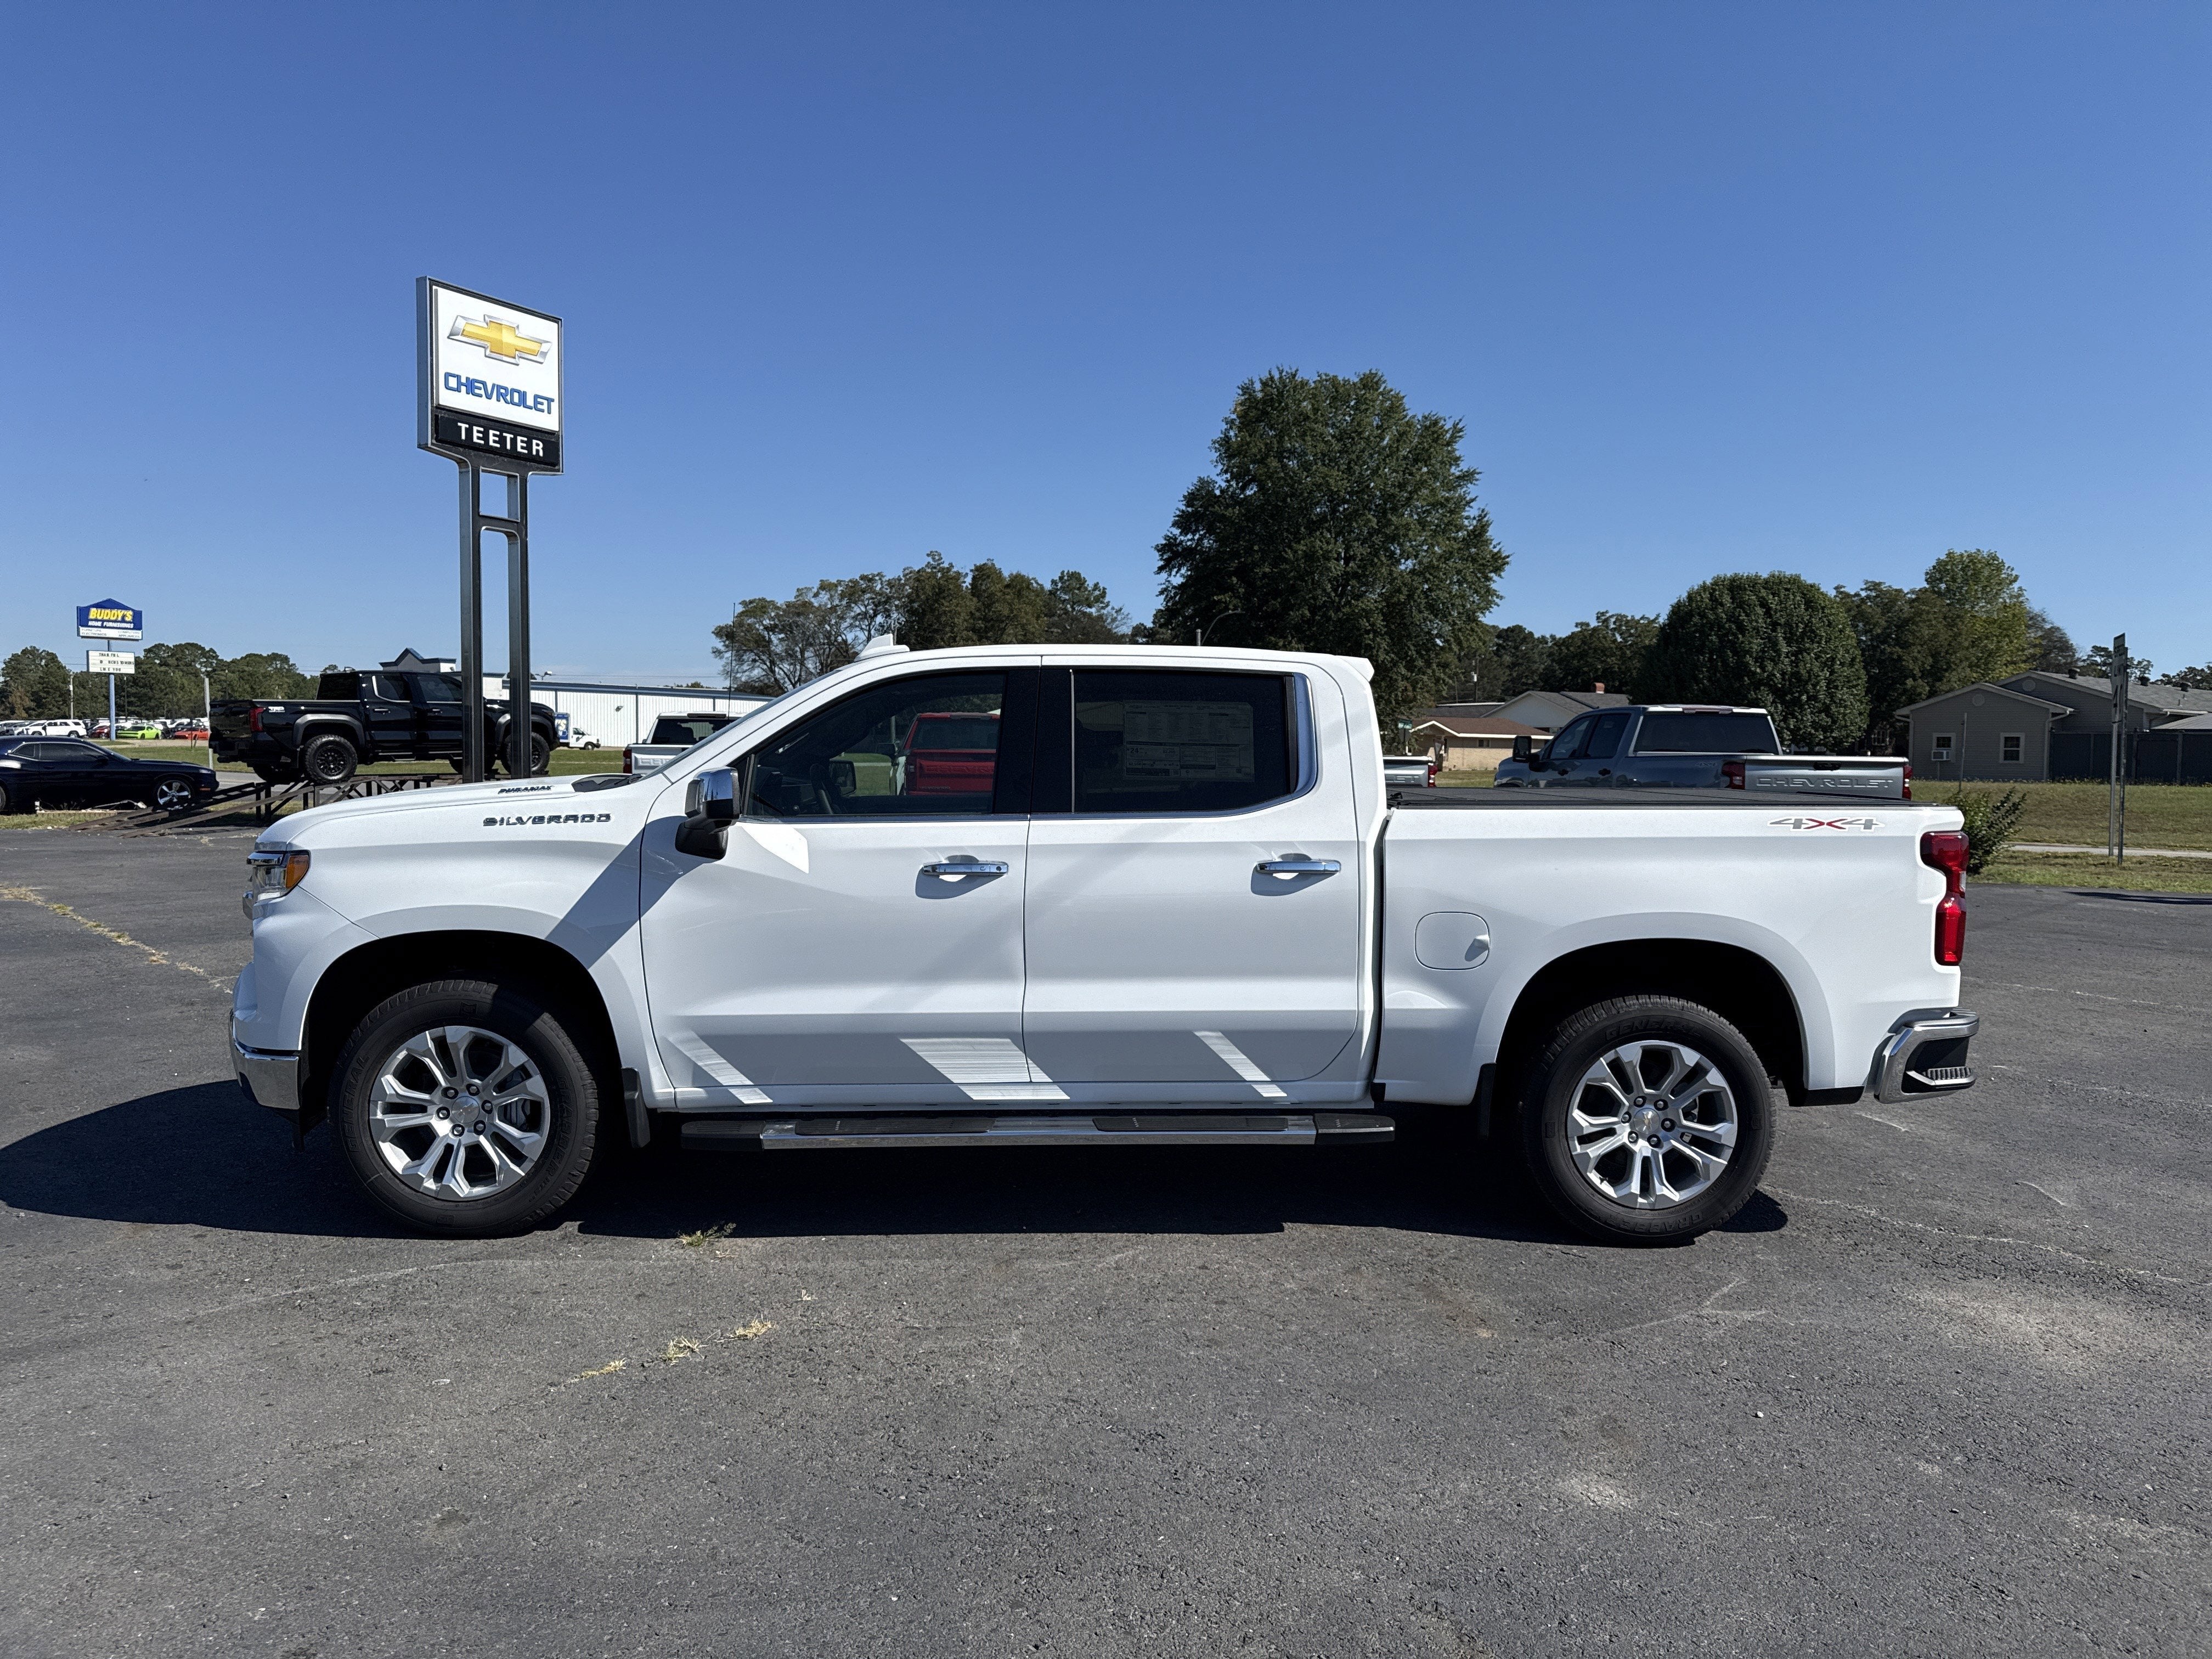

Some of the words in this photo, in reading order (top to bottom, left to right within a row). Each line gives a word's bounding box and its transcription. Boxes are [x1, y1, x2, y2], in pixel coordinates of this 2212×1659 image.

[444, 371, 555, 414] CHEVROLET
[457, 422, 544, 457] TEETER
[89, 608, 133, 622] BUDDY'S
[498, 785, 555, 794] DURAMAX
[1756, 778, 1893, 788] CHEVROLET
[483, 813, 612, 827] SILVERADO
[342, 1056, 370, 1152] GENERAL
